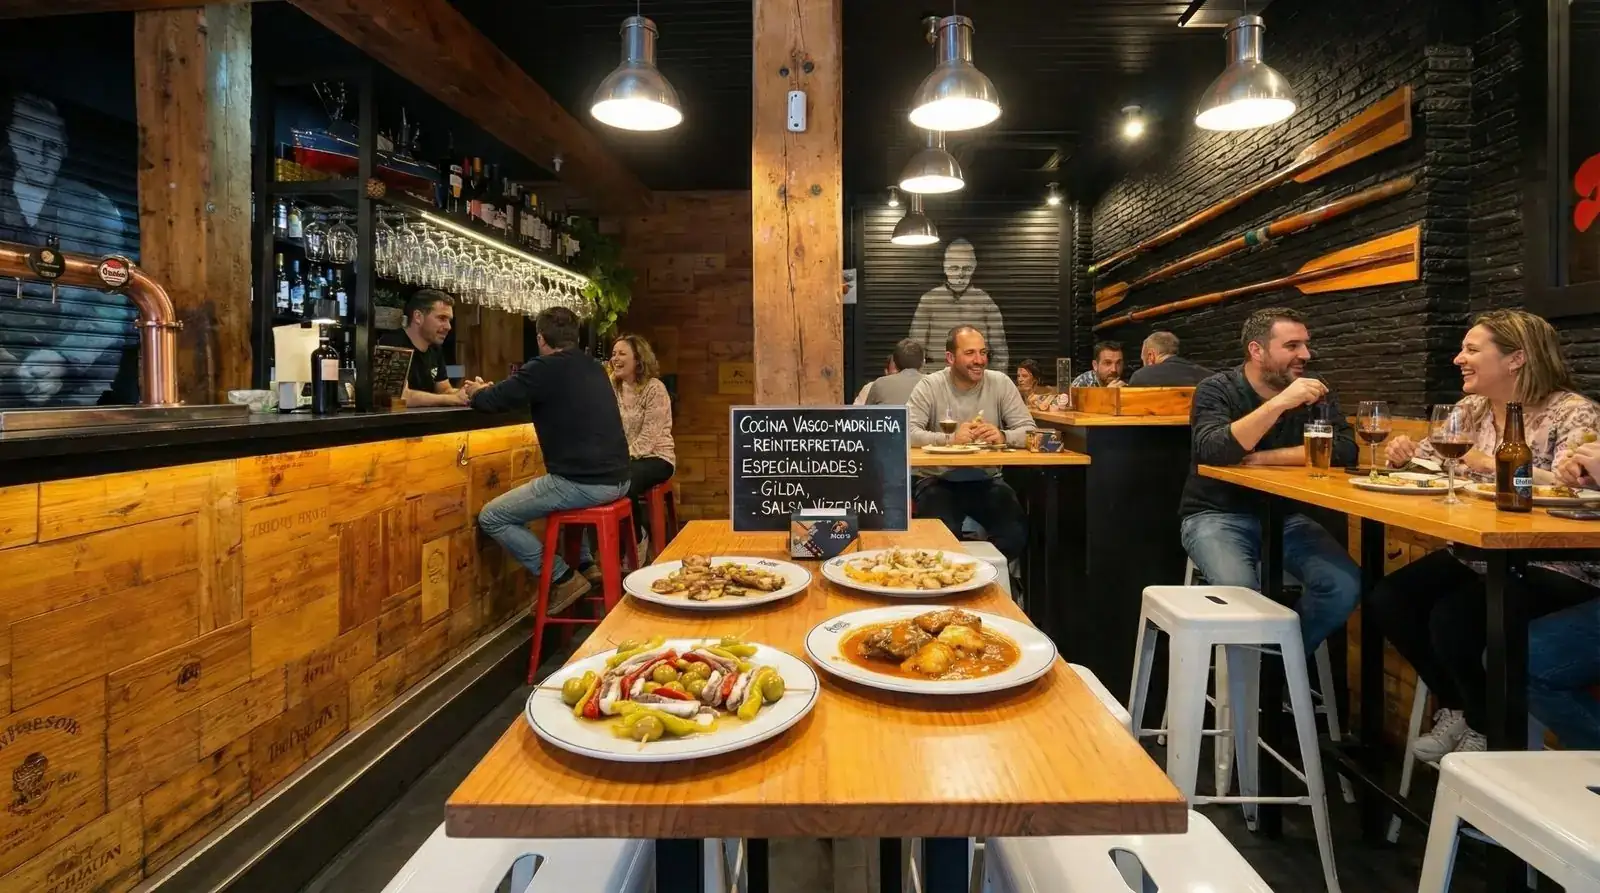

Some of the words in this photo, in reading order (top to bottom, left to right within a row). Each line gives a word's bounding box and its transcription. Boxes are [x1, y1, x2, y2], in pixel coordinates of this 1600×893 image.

[739, 415, 788, 434] COCINA
[793, 415, 901, 434] VASCO-MADRILEÑA
[741, 457, 863, 475] ESPECIALIDADES:
